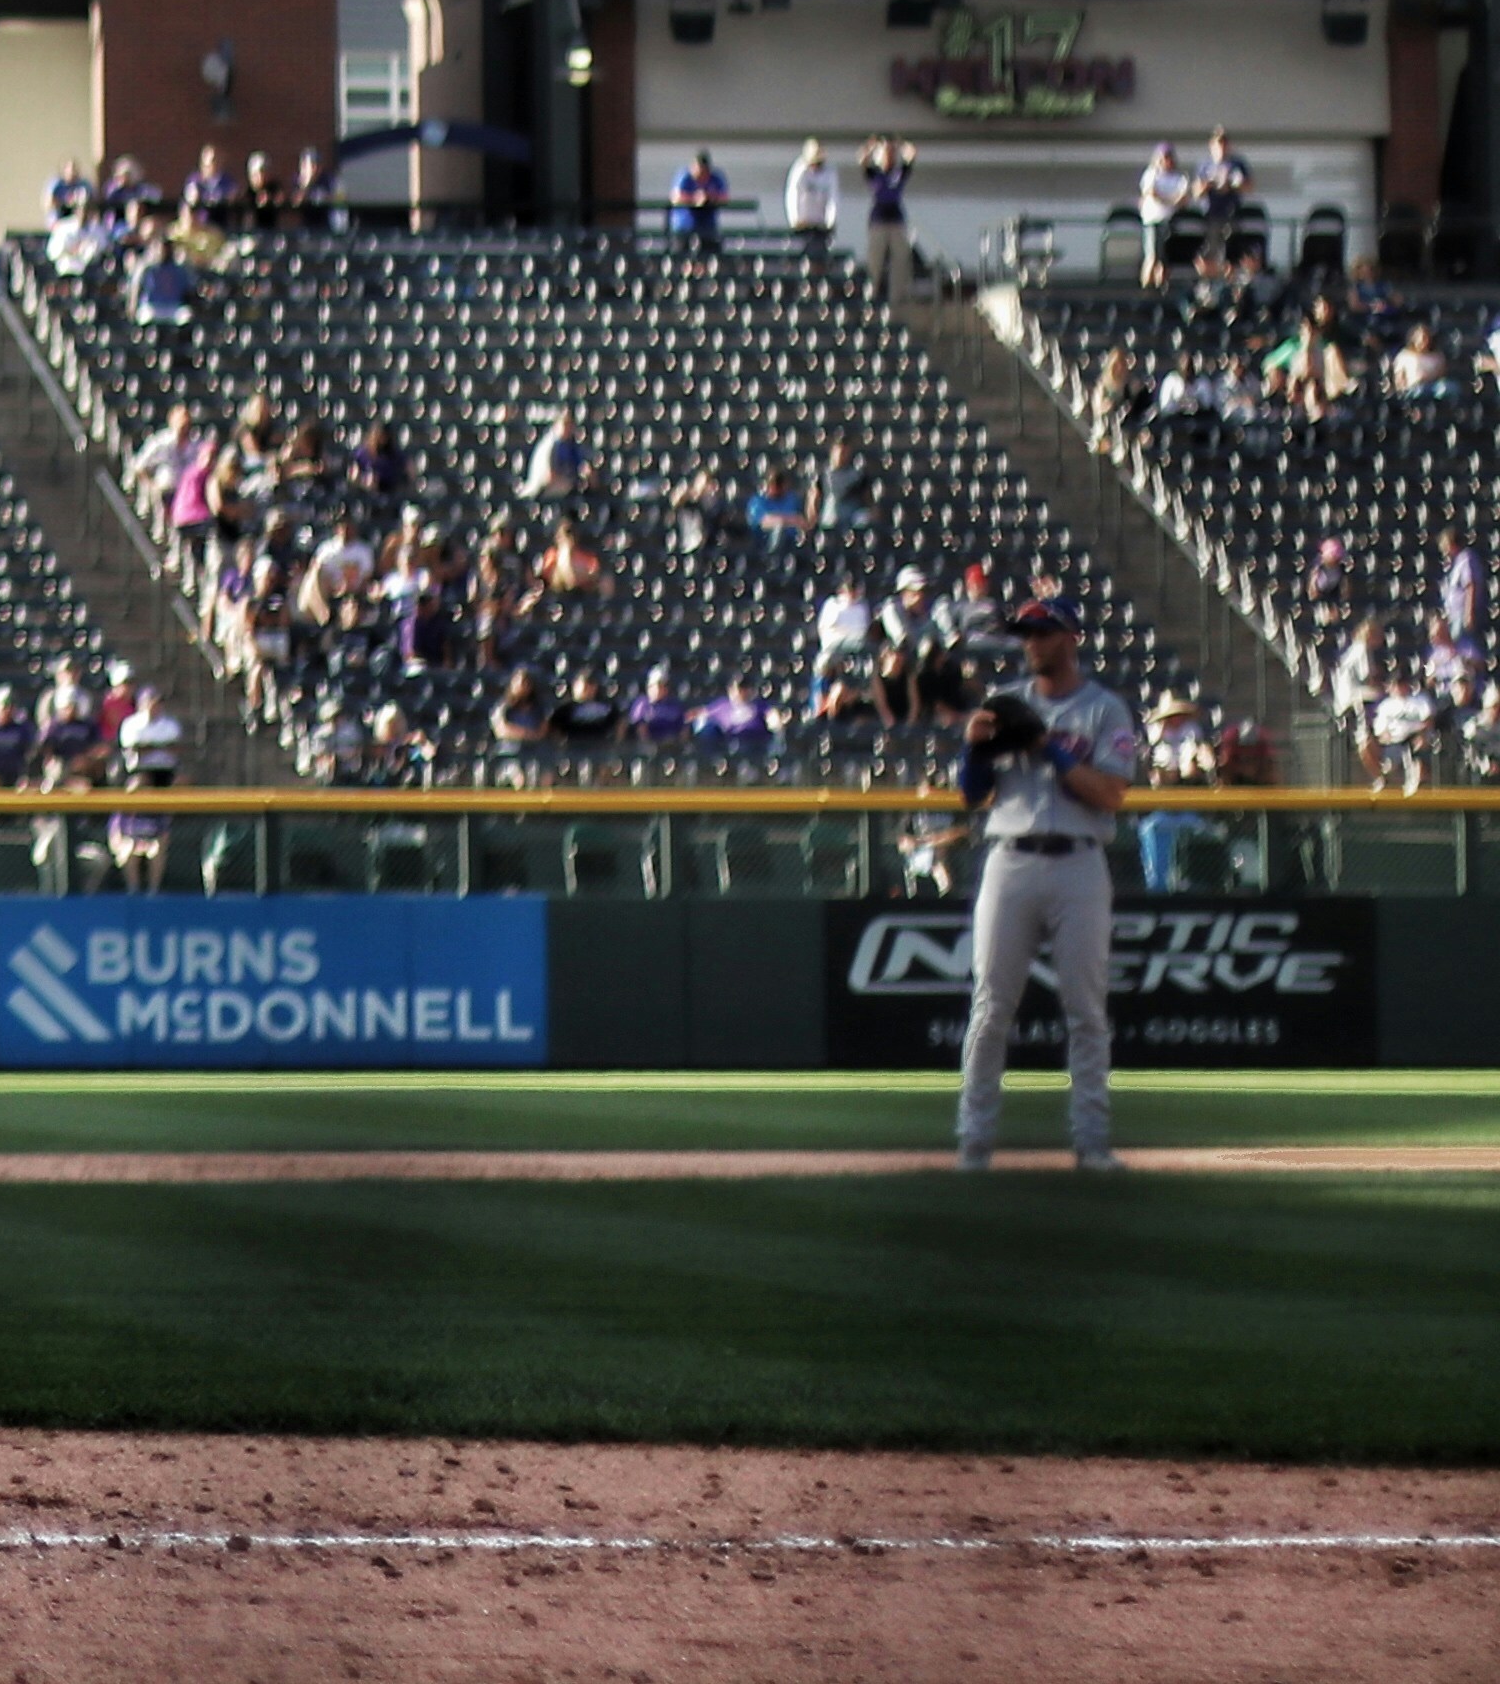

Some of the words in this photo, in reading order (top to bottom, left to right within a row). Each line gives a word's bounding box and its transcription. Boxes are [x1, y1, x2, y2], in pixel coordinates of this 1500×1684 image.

[85, 929, 320, 985] BURNS
[1110, 913, 1300, 954] PTIC
[115, 986, 534, 1043] McDONNELL
